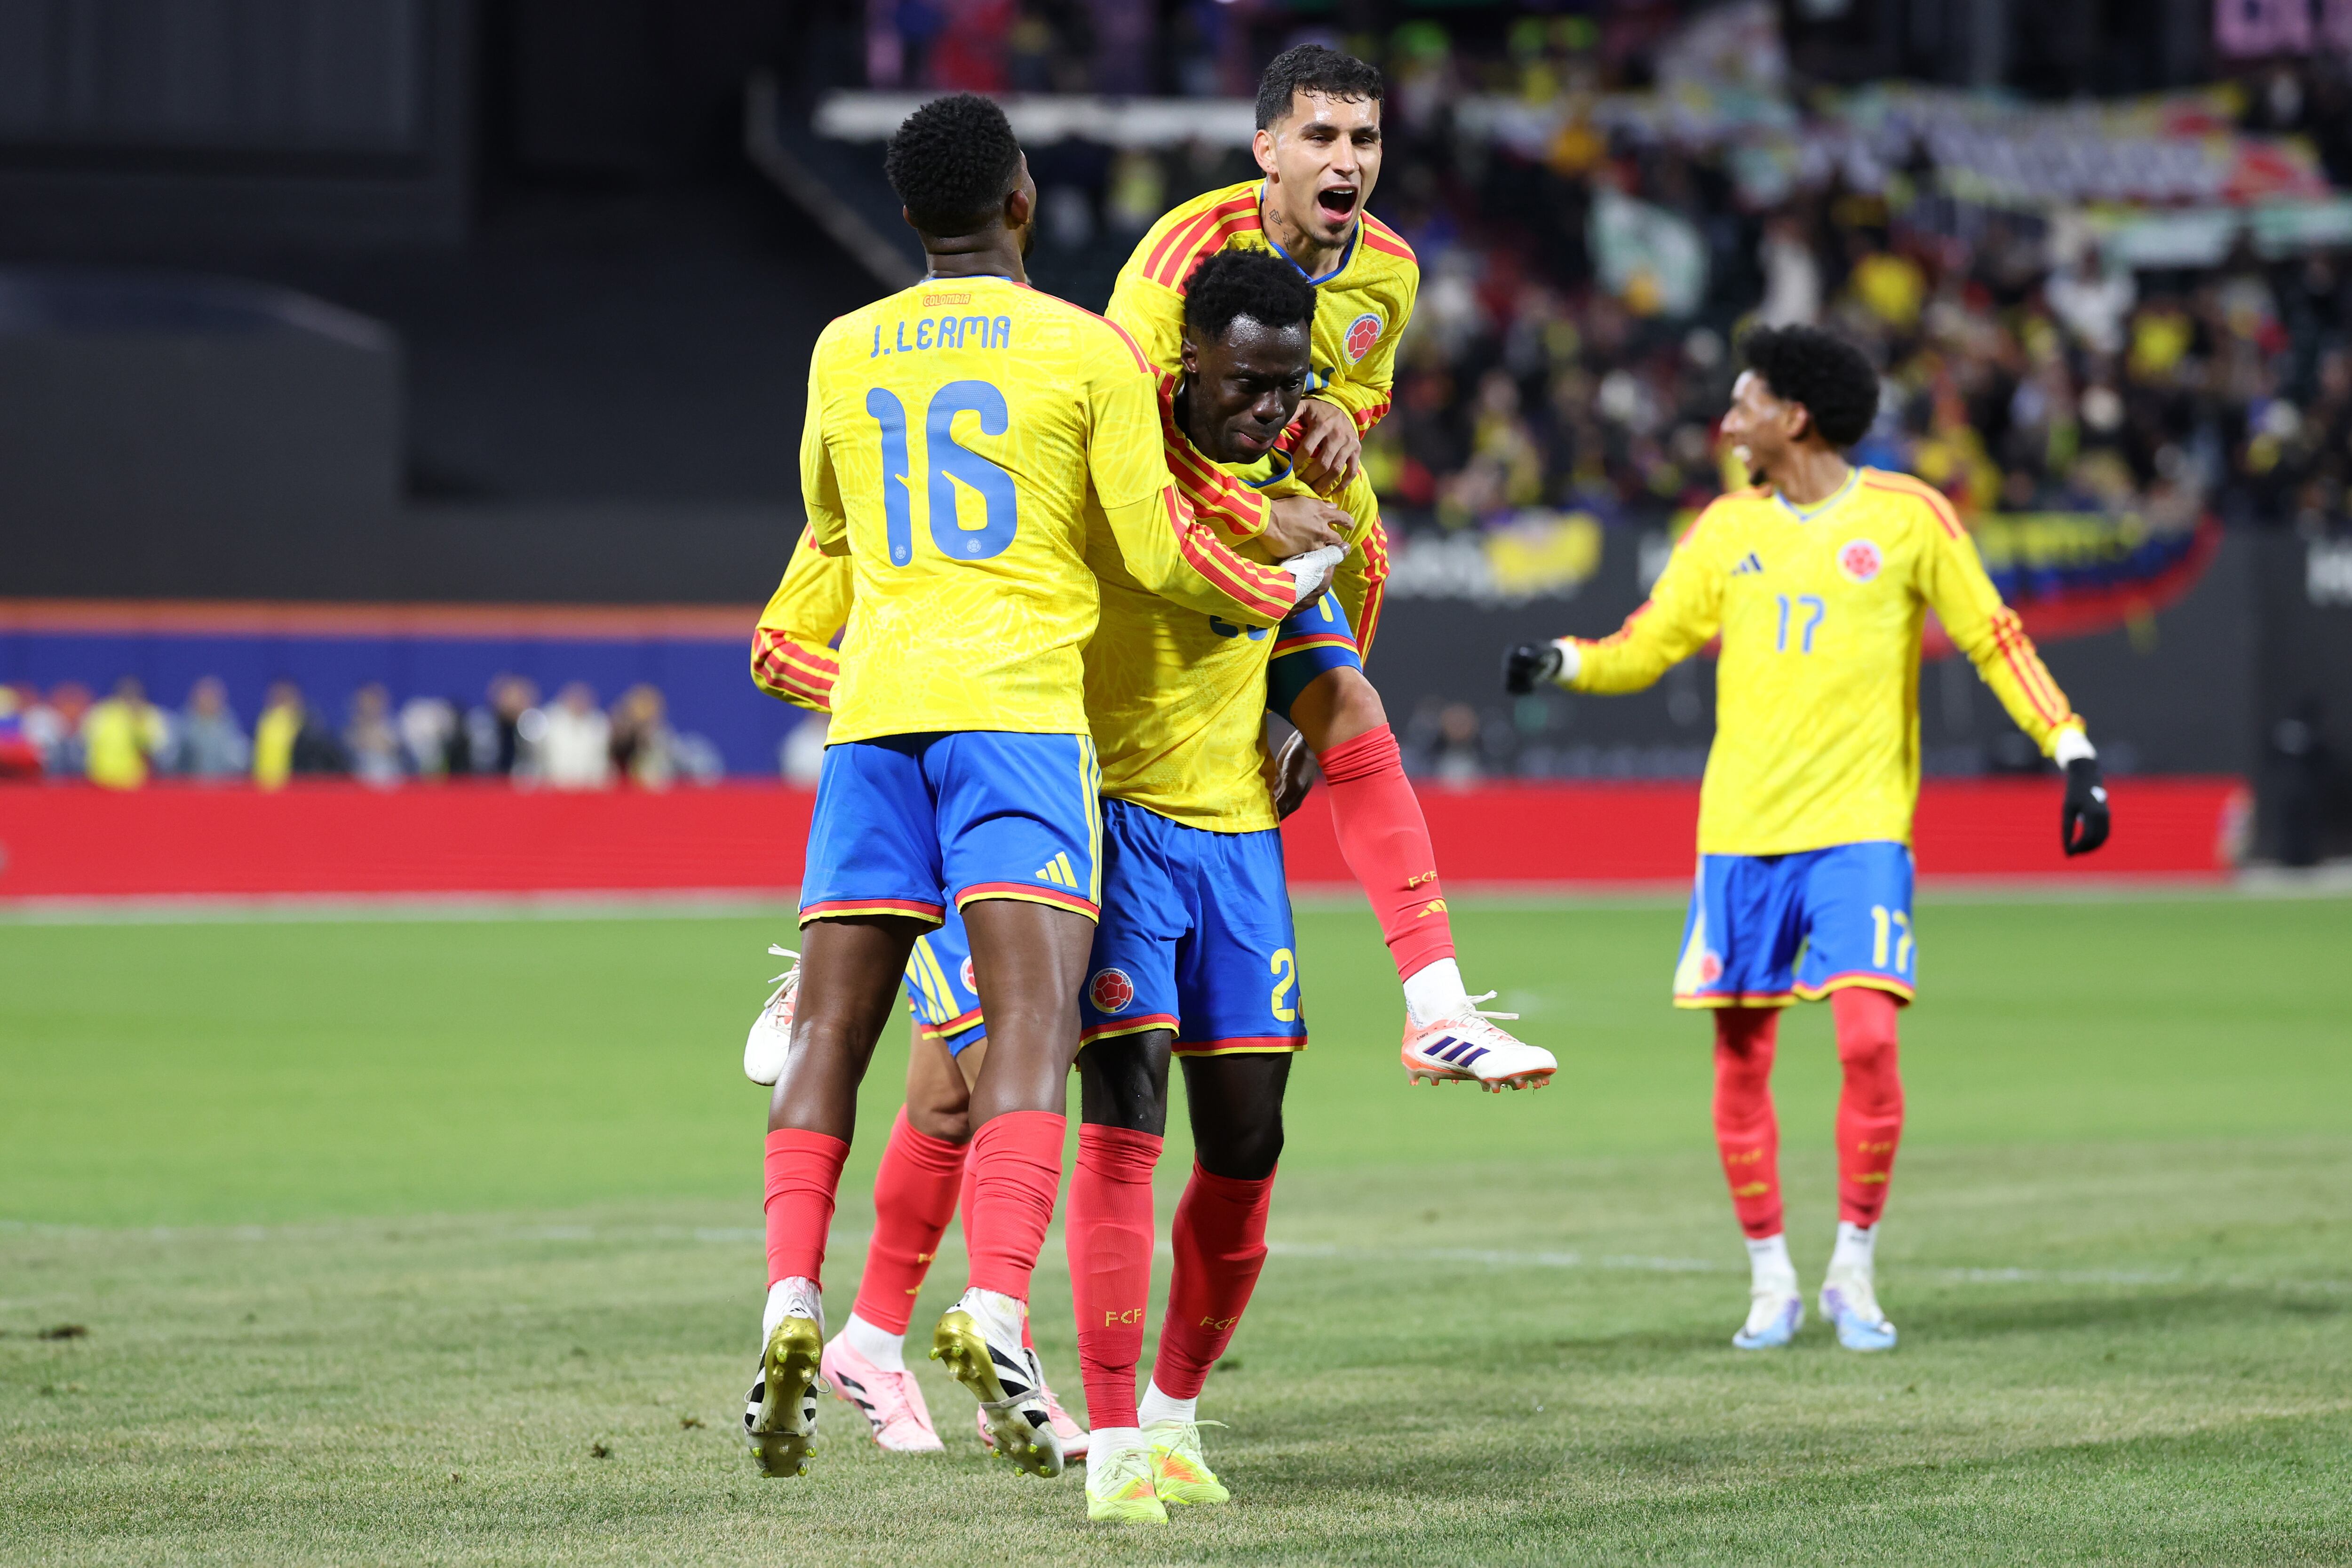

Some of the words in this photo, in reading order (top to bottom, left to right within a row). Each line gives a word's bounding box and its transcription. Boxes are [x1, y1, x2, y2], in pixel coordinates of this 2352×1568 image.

[923, 294, 971, 307] COLOMBIA
[870, 316, 1011, 358] J.LERMA
[866, 380, 1017, 567] 16
[1776, 594, 1825, 653] 17
[1408, 871, 1438, 888] FCF
[1871, 904, 1912, 974] 17
[1271, 948, 1304, 1019] 2
[1105, 1308, 1142, 1327] FCF
[1200, 1316, 1237, 1330] FCF
